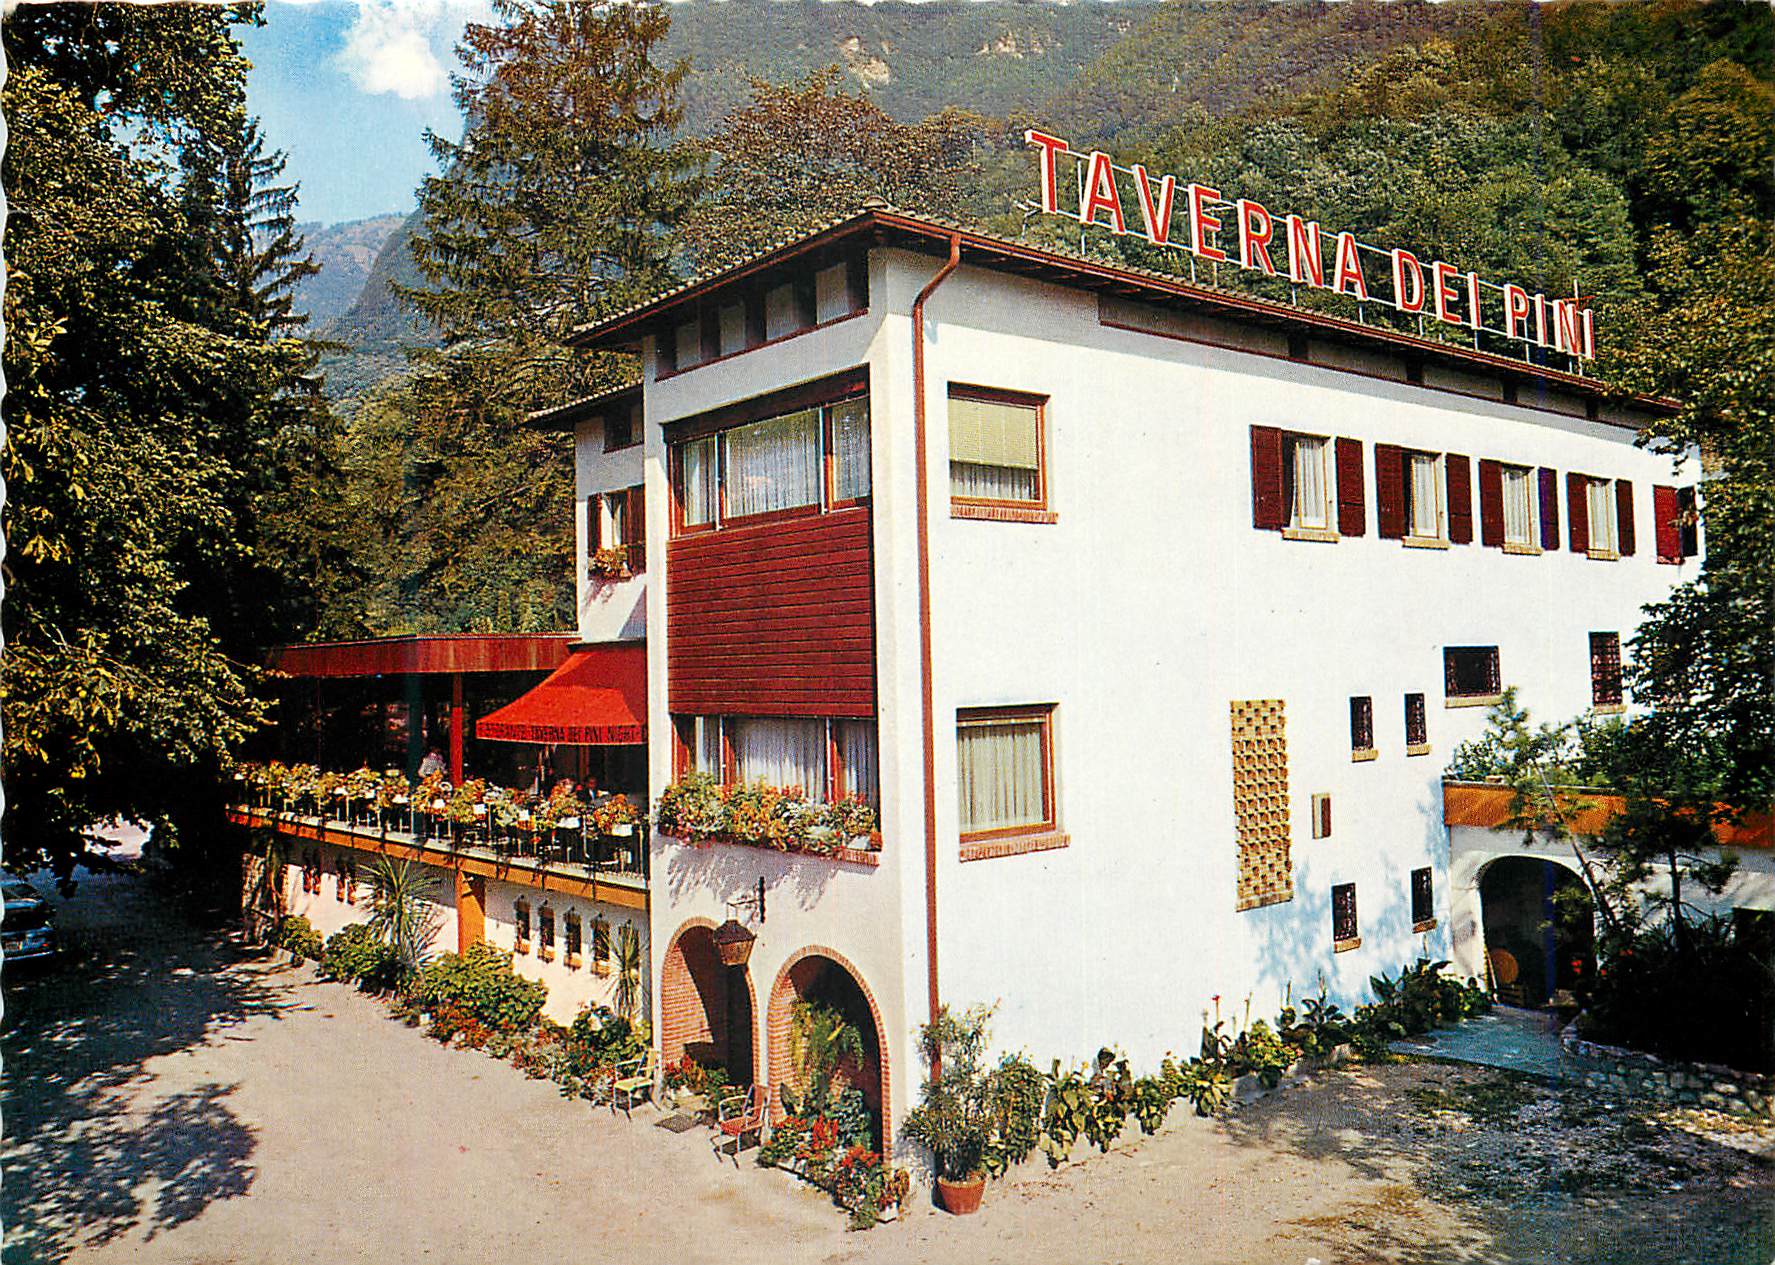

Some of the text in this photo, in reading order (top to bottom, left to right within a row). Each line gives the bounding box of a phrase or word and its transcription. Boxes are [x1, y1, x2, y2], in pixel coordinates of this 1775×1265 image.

[1024, 129, 1596, 360] TAVERNA DEI PINI
[584, 725, 603, 743] PINI
